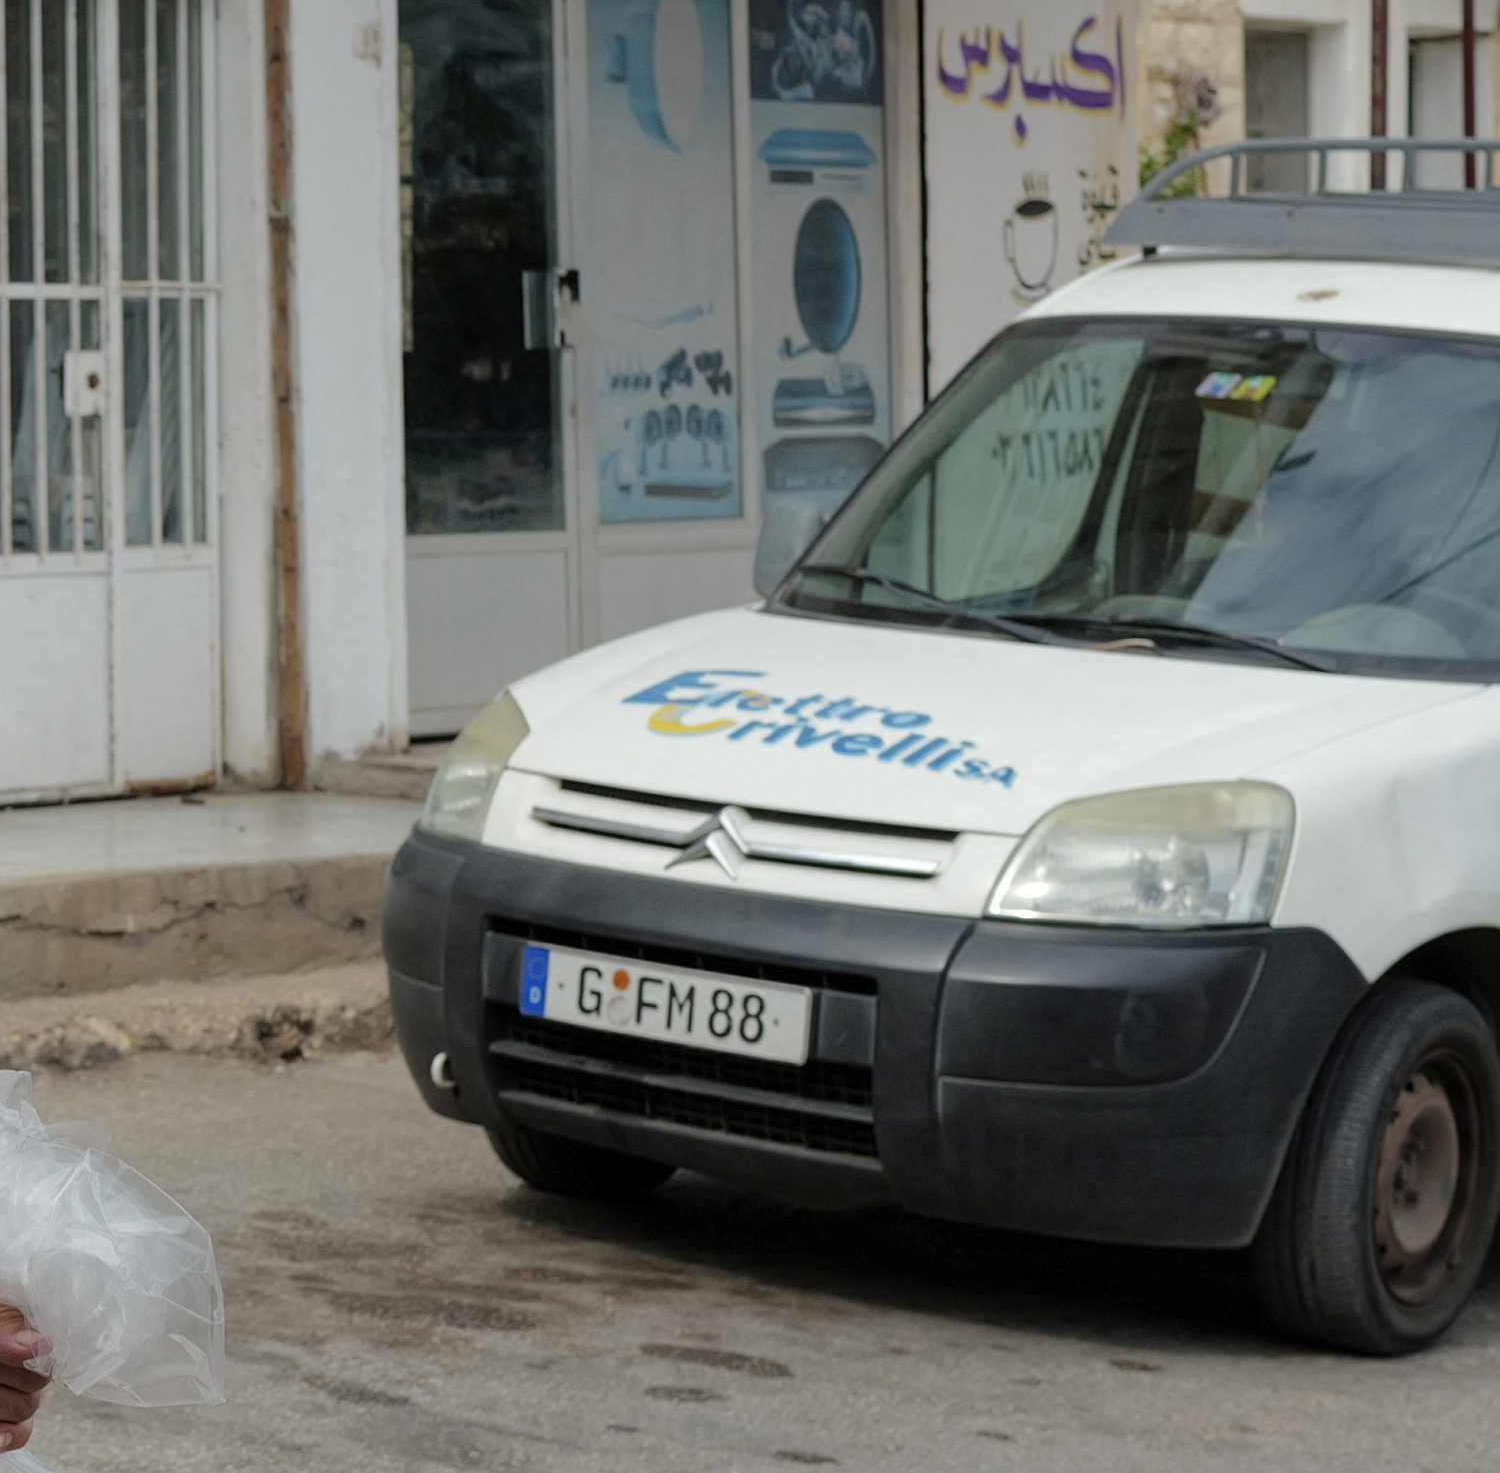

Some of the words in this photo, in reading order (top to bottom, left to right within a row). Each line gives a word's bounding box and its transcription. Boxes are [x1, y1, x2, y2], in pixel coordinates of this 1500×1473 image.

[621, 669, 934, 730] Elettro
[647, 690, 978, 772] Crivelli
[576, 965, 604, 1017] G
[635, 975, 697, 1035] FM
[707, 987, 767, 1045] 88
